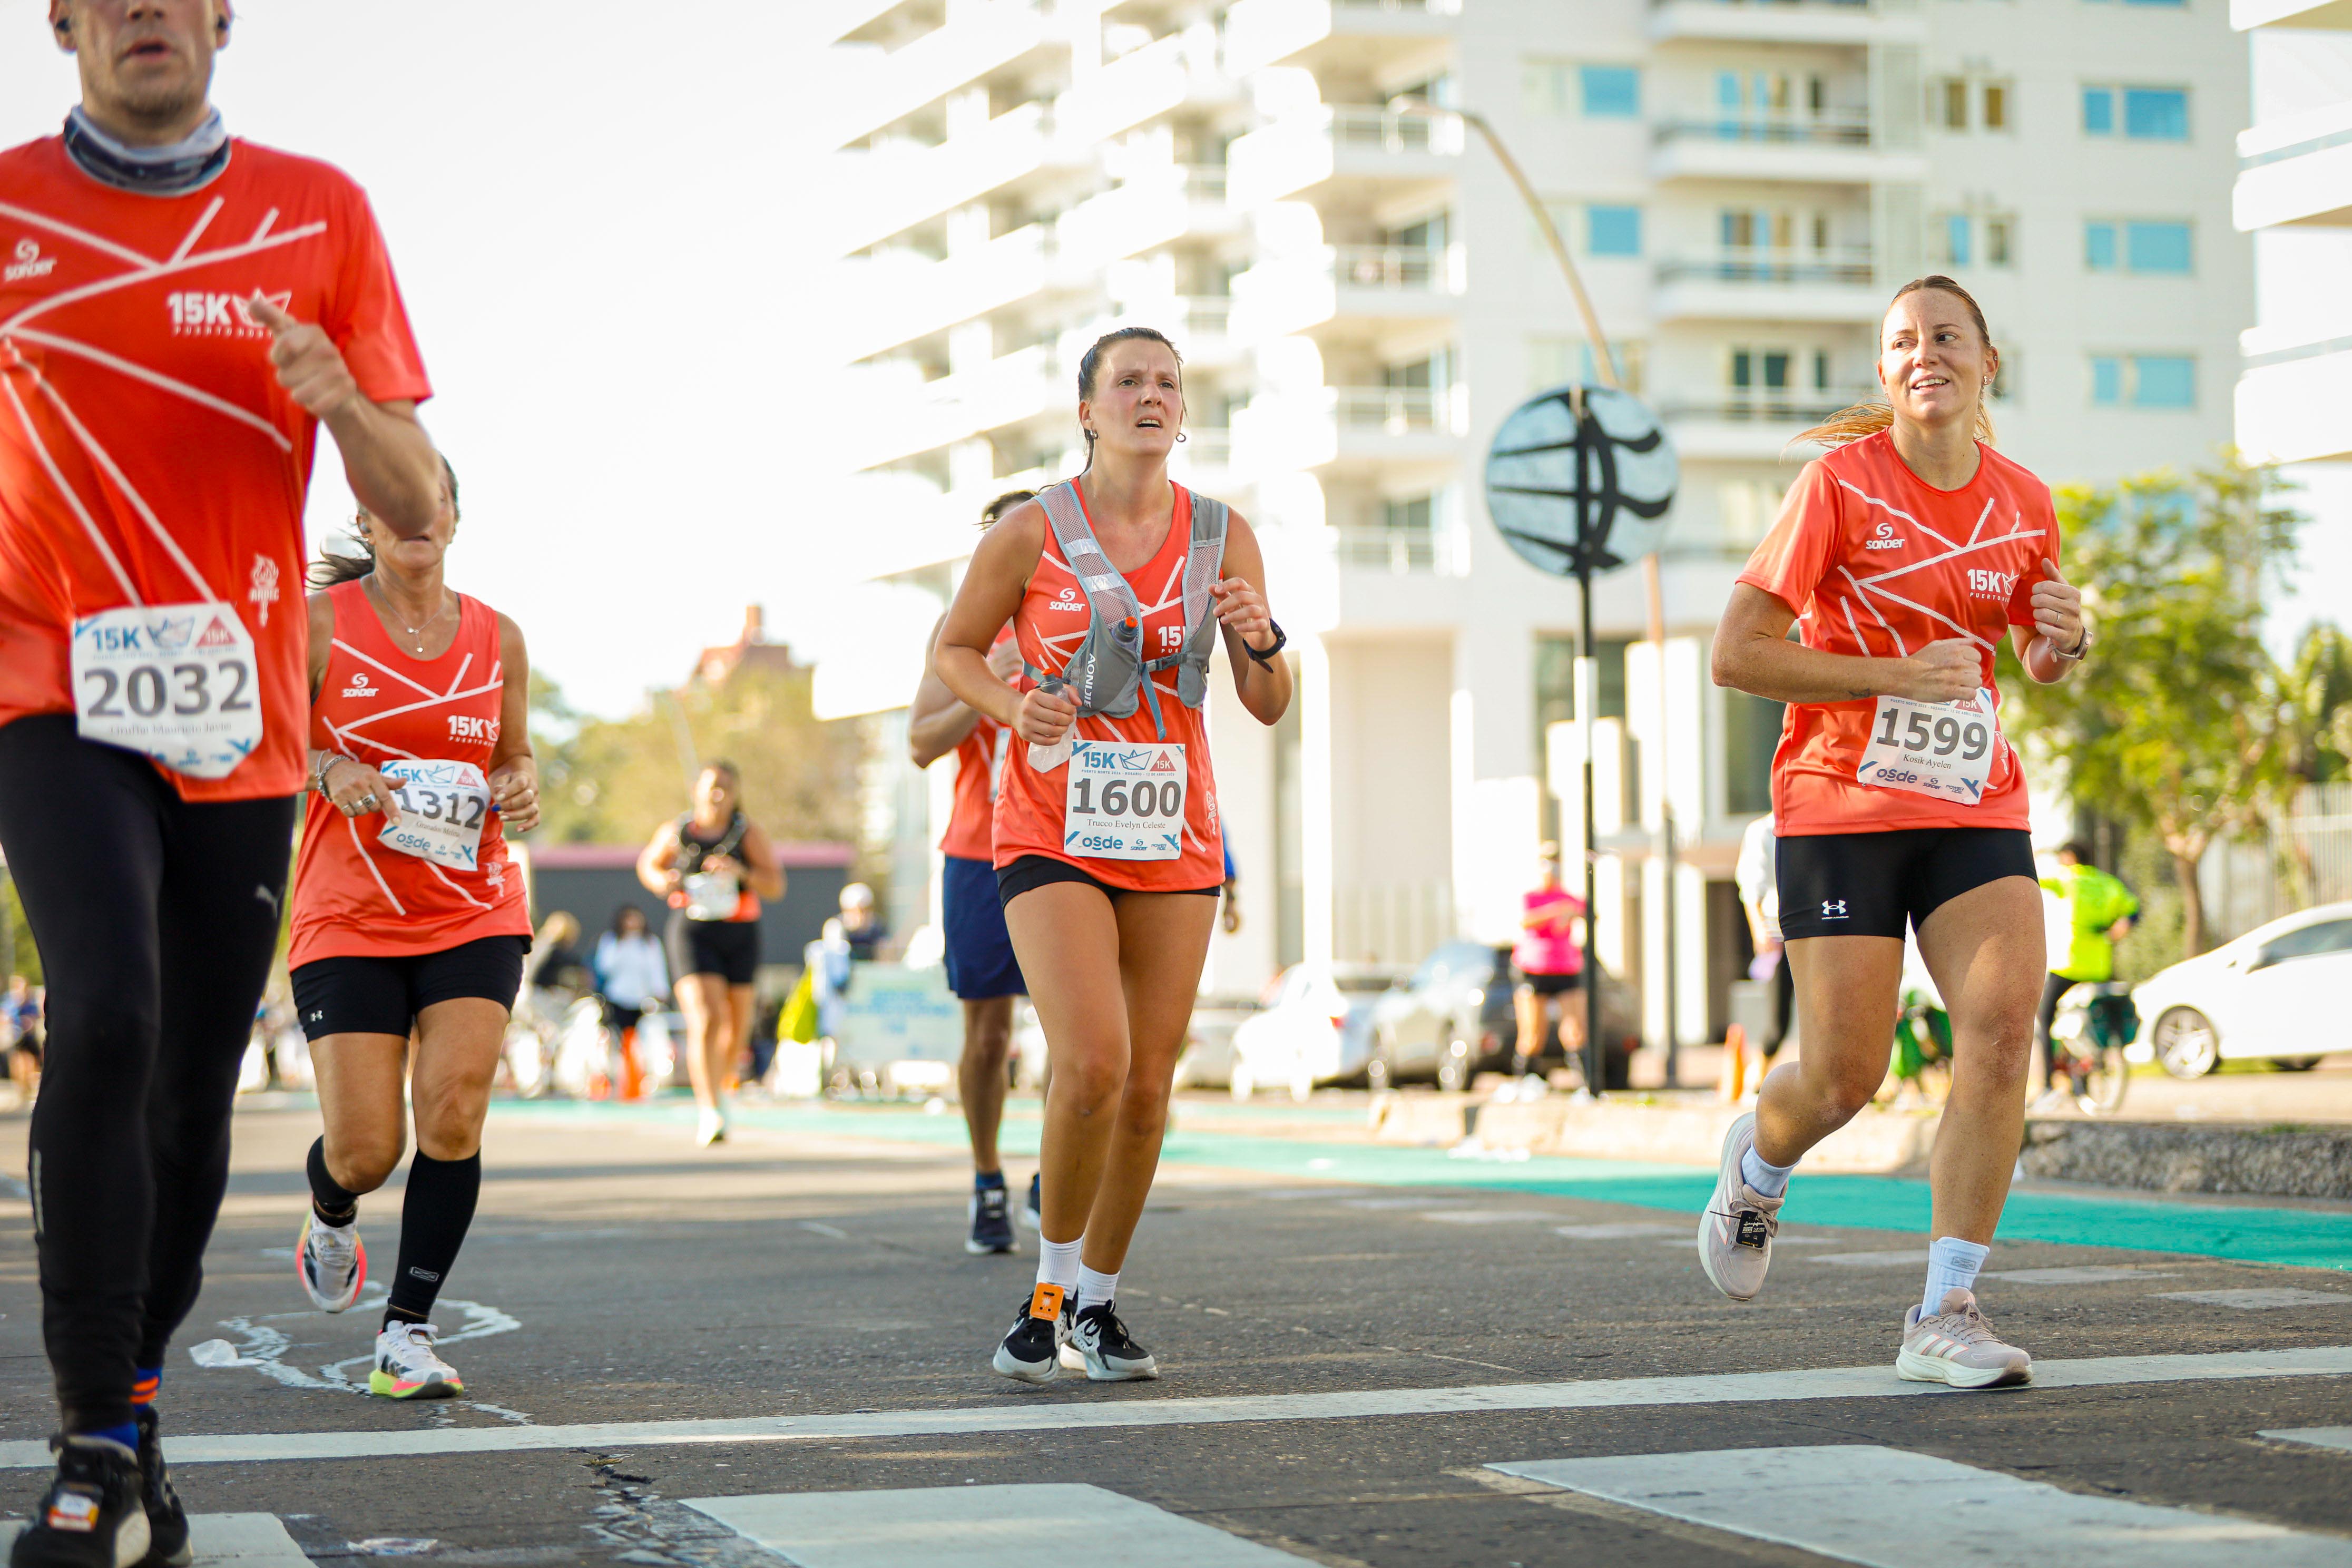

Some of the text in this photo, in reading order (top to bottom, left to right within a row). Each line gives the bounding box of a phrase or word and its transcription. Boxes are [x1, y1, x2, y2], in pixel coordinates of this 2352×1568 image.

[168, 292, 232, 325] 15K
[1967, 569, 2002, 593] 15K
[92, 625, 141, 651] 15K
[1158, 626, 1185, 646] 15
[84, 660, 252, 718] 2032
[1084, 653, 1096, 708] AONIJIE
[1963, 700, 1977, 709] 15K
[447, 715, 484, 738] 15K
[1876, 708, 1987, 760] 1599
[1083, 751, 1116, 769] 15K
[1156, 760, 1172, 769] 15K
[1903, 754, 1951, 769] Kosik Ayelen
[1876, 768, 1917, 783] osde
[1073, 778, 1181, 817] 1600
[395, 788, 485, 830] 1312
[1115, 820, 1140, 830] Evelyn
[396, 834, 430, 850] osde
[1082, 836, 1123, 850] osde
